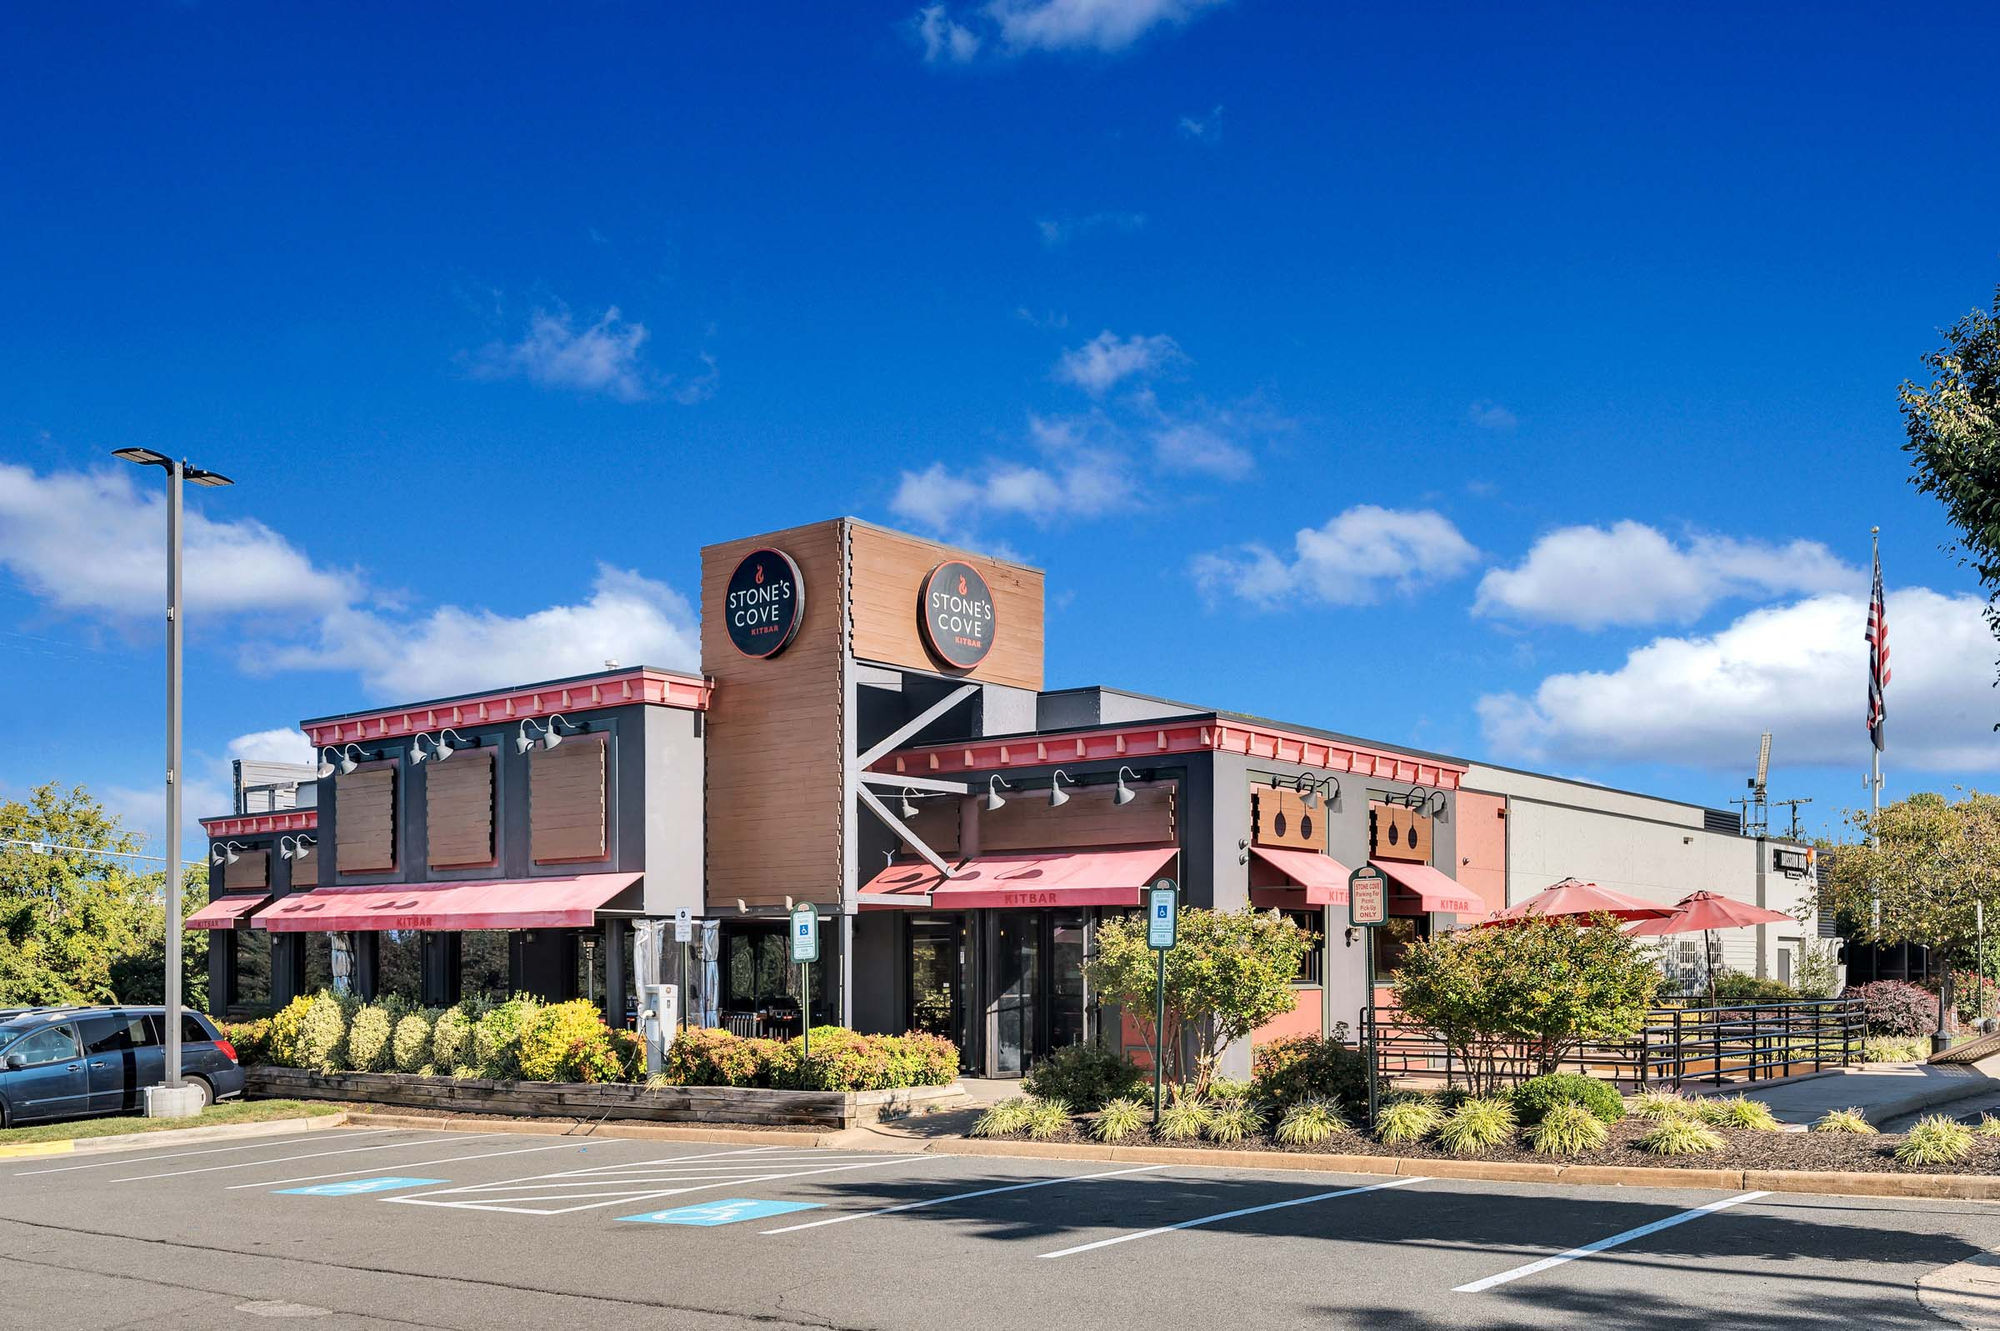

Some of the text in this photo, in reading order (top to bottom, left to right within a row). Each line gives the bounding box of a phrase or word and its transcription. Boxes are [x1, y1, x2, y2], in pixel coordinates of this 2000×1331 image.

[729, 579, 791, 609] STONE'S
[932, 591, 992, 620] STONE'S
[734, 604, 780, 627] COVE
[750, 624, 780, 636] KITBAR
[937, 613, 982, 638] COVE
[954, 635, 983, 649] KITBAR
[1004, 892, 1057, 905] KITBAR
[1440, 899, 1469, 911] KITBAR
[396, 916, 432, 927] KITBAR
